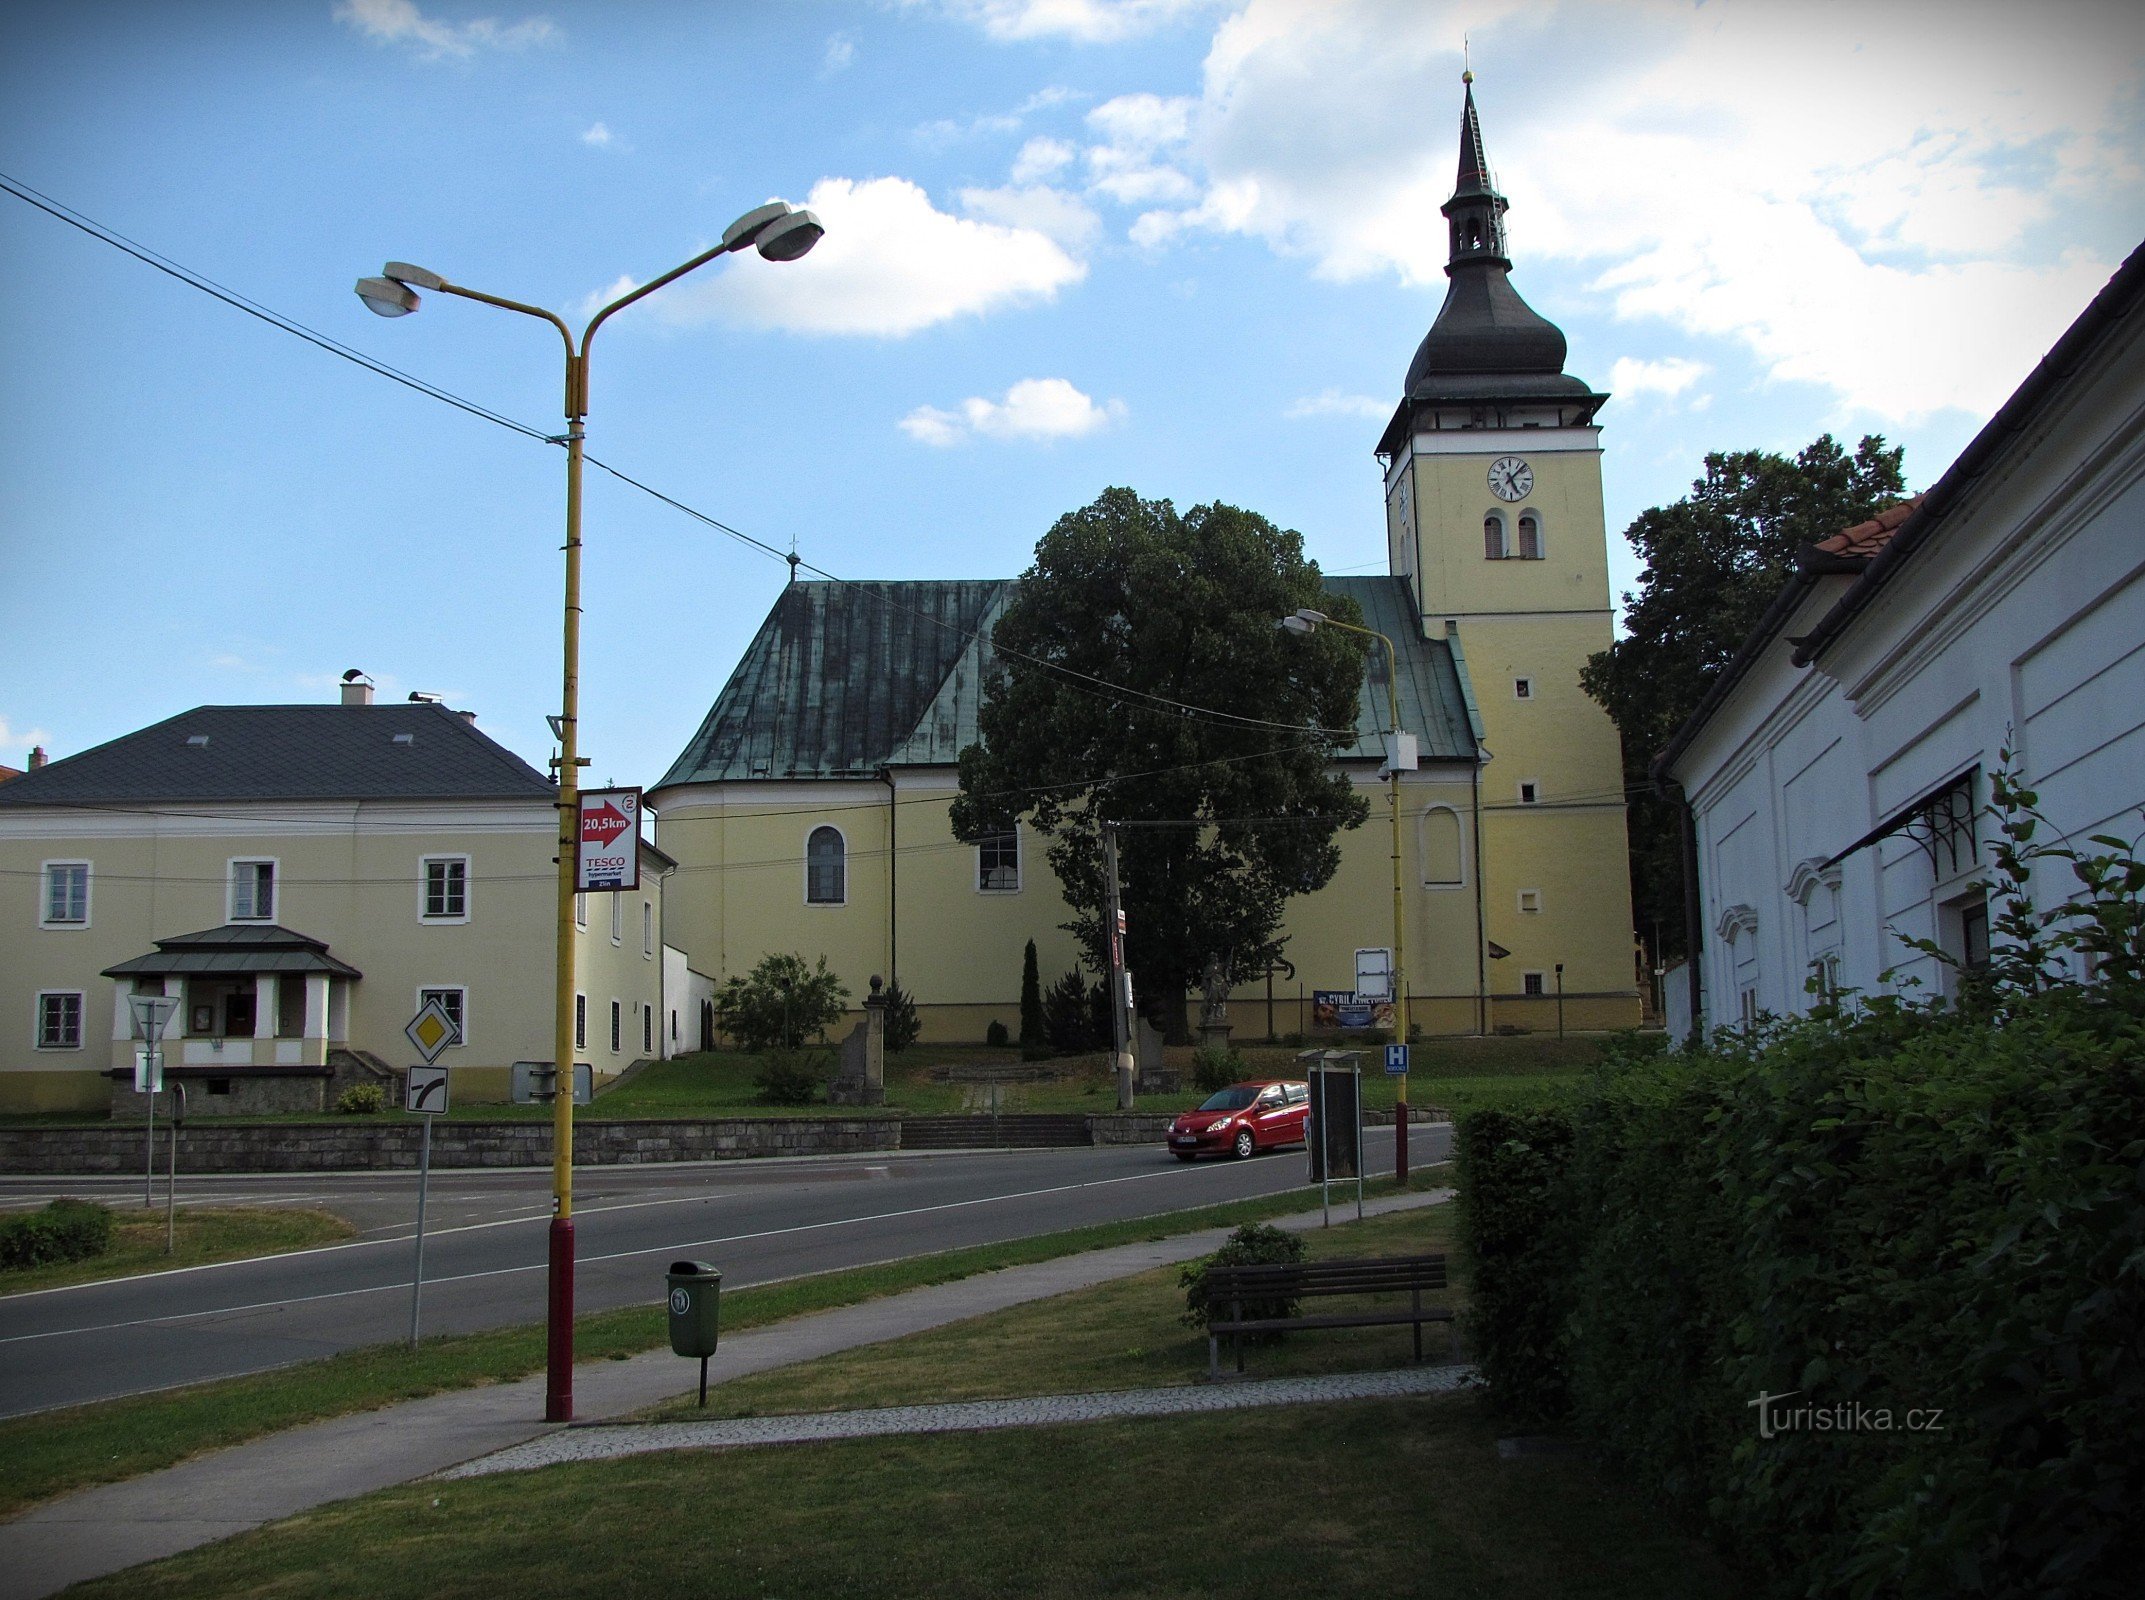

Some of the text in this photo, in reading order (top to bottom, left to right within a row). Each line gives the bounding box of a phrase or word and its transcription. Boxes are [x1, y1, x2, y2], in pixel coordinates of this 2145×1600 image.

[584, 817, 626, 831] 20,5km
[586, 857, 626, 868] TESCO
[588, 870, 622, 879] hypermarket
[1328, 994, 1351, 1005] CYRIL
[1389, 1047, 1403, 1065] H
